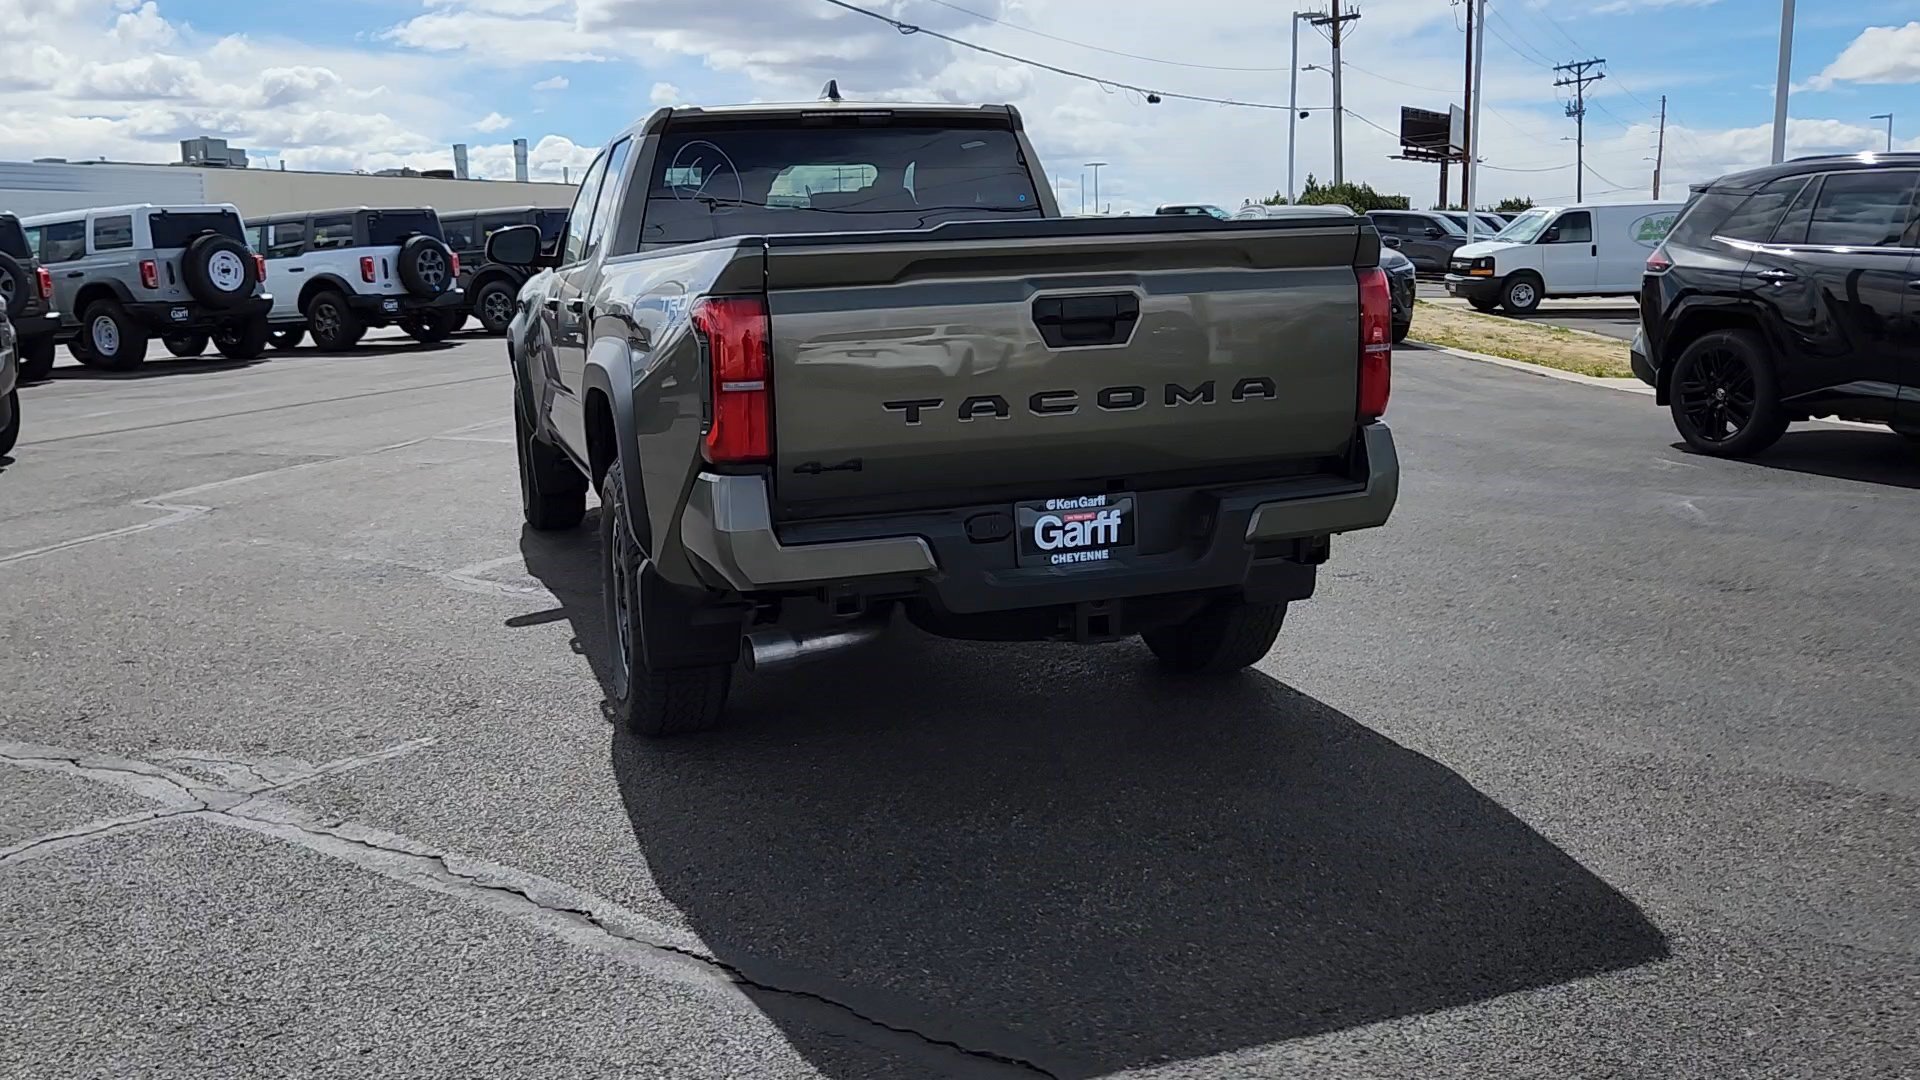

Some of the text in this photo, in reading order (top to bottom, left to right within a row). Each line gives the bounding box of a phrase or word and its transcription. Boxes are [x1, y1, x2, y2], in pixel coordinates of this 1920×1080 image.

[882, 377, 1277, 425] TACOMA
[1056, 495, 1106, 510] Ken Garff
[1035, 510, 1121, 550] Garff
[1051, 549, 1109, 564] CHEYENNE
